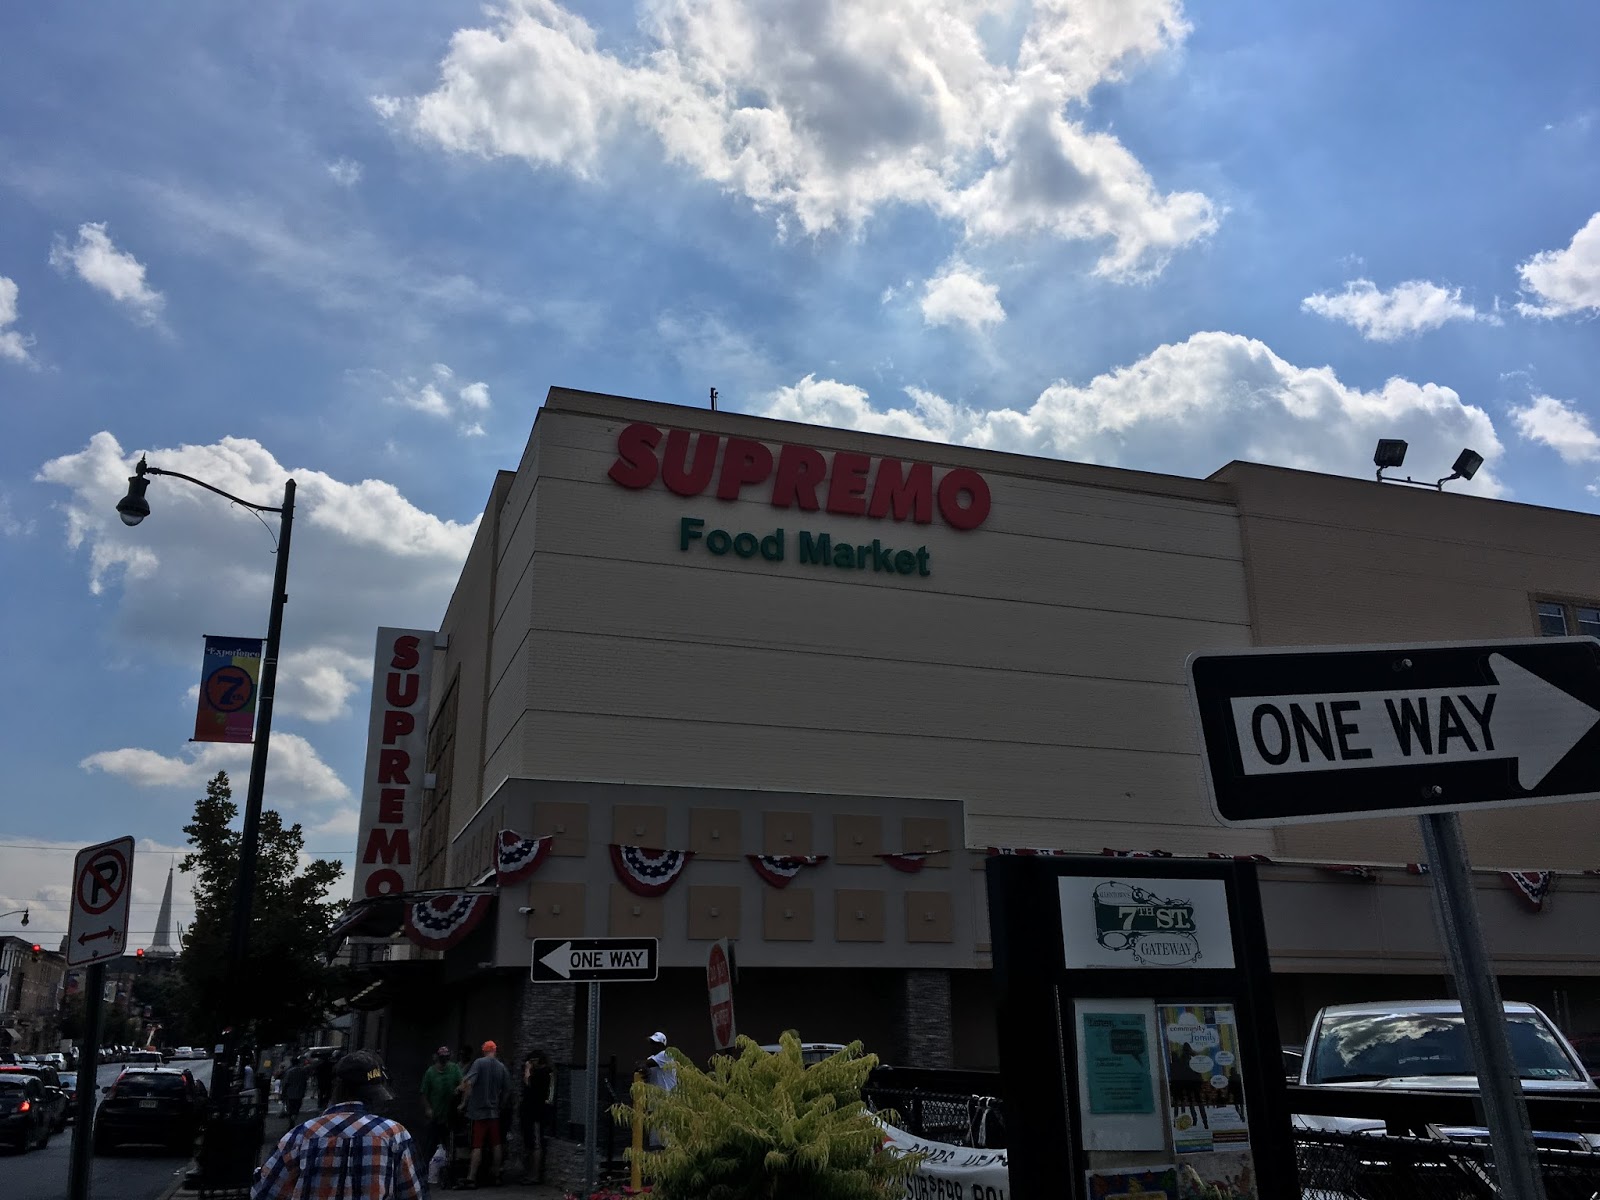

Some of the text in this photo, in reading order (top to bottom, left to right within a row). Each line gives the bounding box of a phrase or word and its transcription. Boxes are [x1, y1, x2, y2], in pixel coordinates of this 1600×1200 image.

[607, 422, 991, 531] SUPREMO
[679, 517, 931, 576] Food Market
[1251, 693, 1497, 765] ONE WAY
[363, 635, 420, 897] SUPREMO
[1118, 906, 1155, 930] 7TH
[570, 951, 643, 968] ONE WAY
[1140, 942, 1192, 956] GATEWAY
[1169, 1025, 1205, 1033] community
